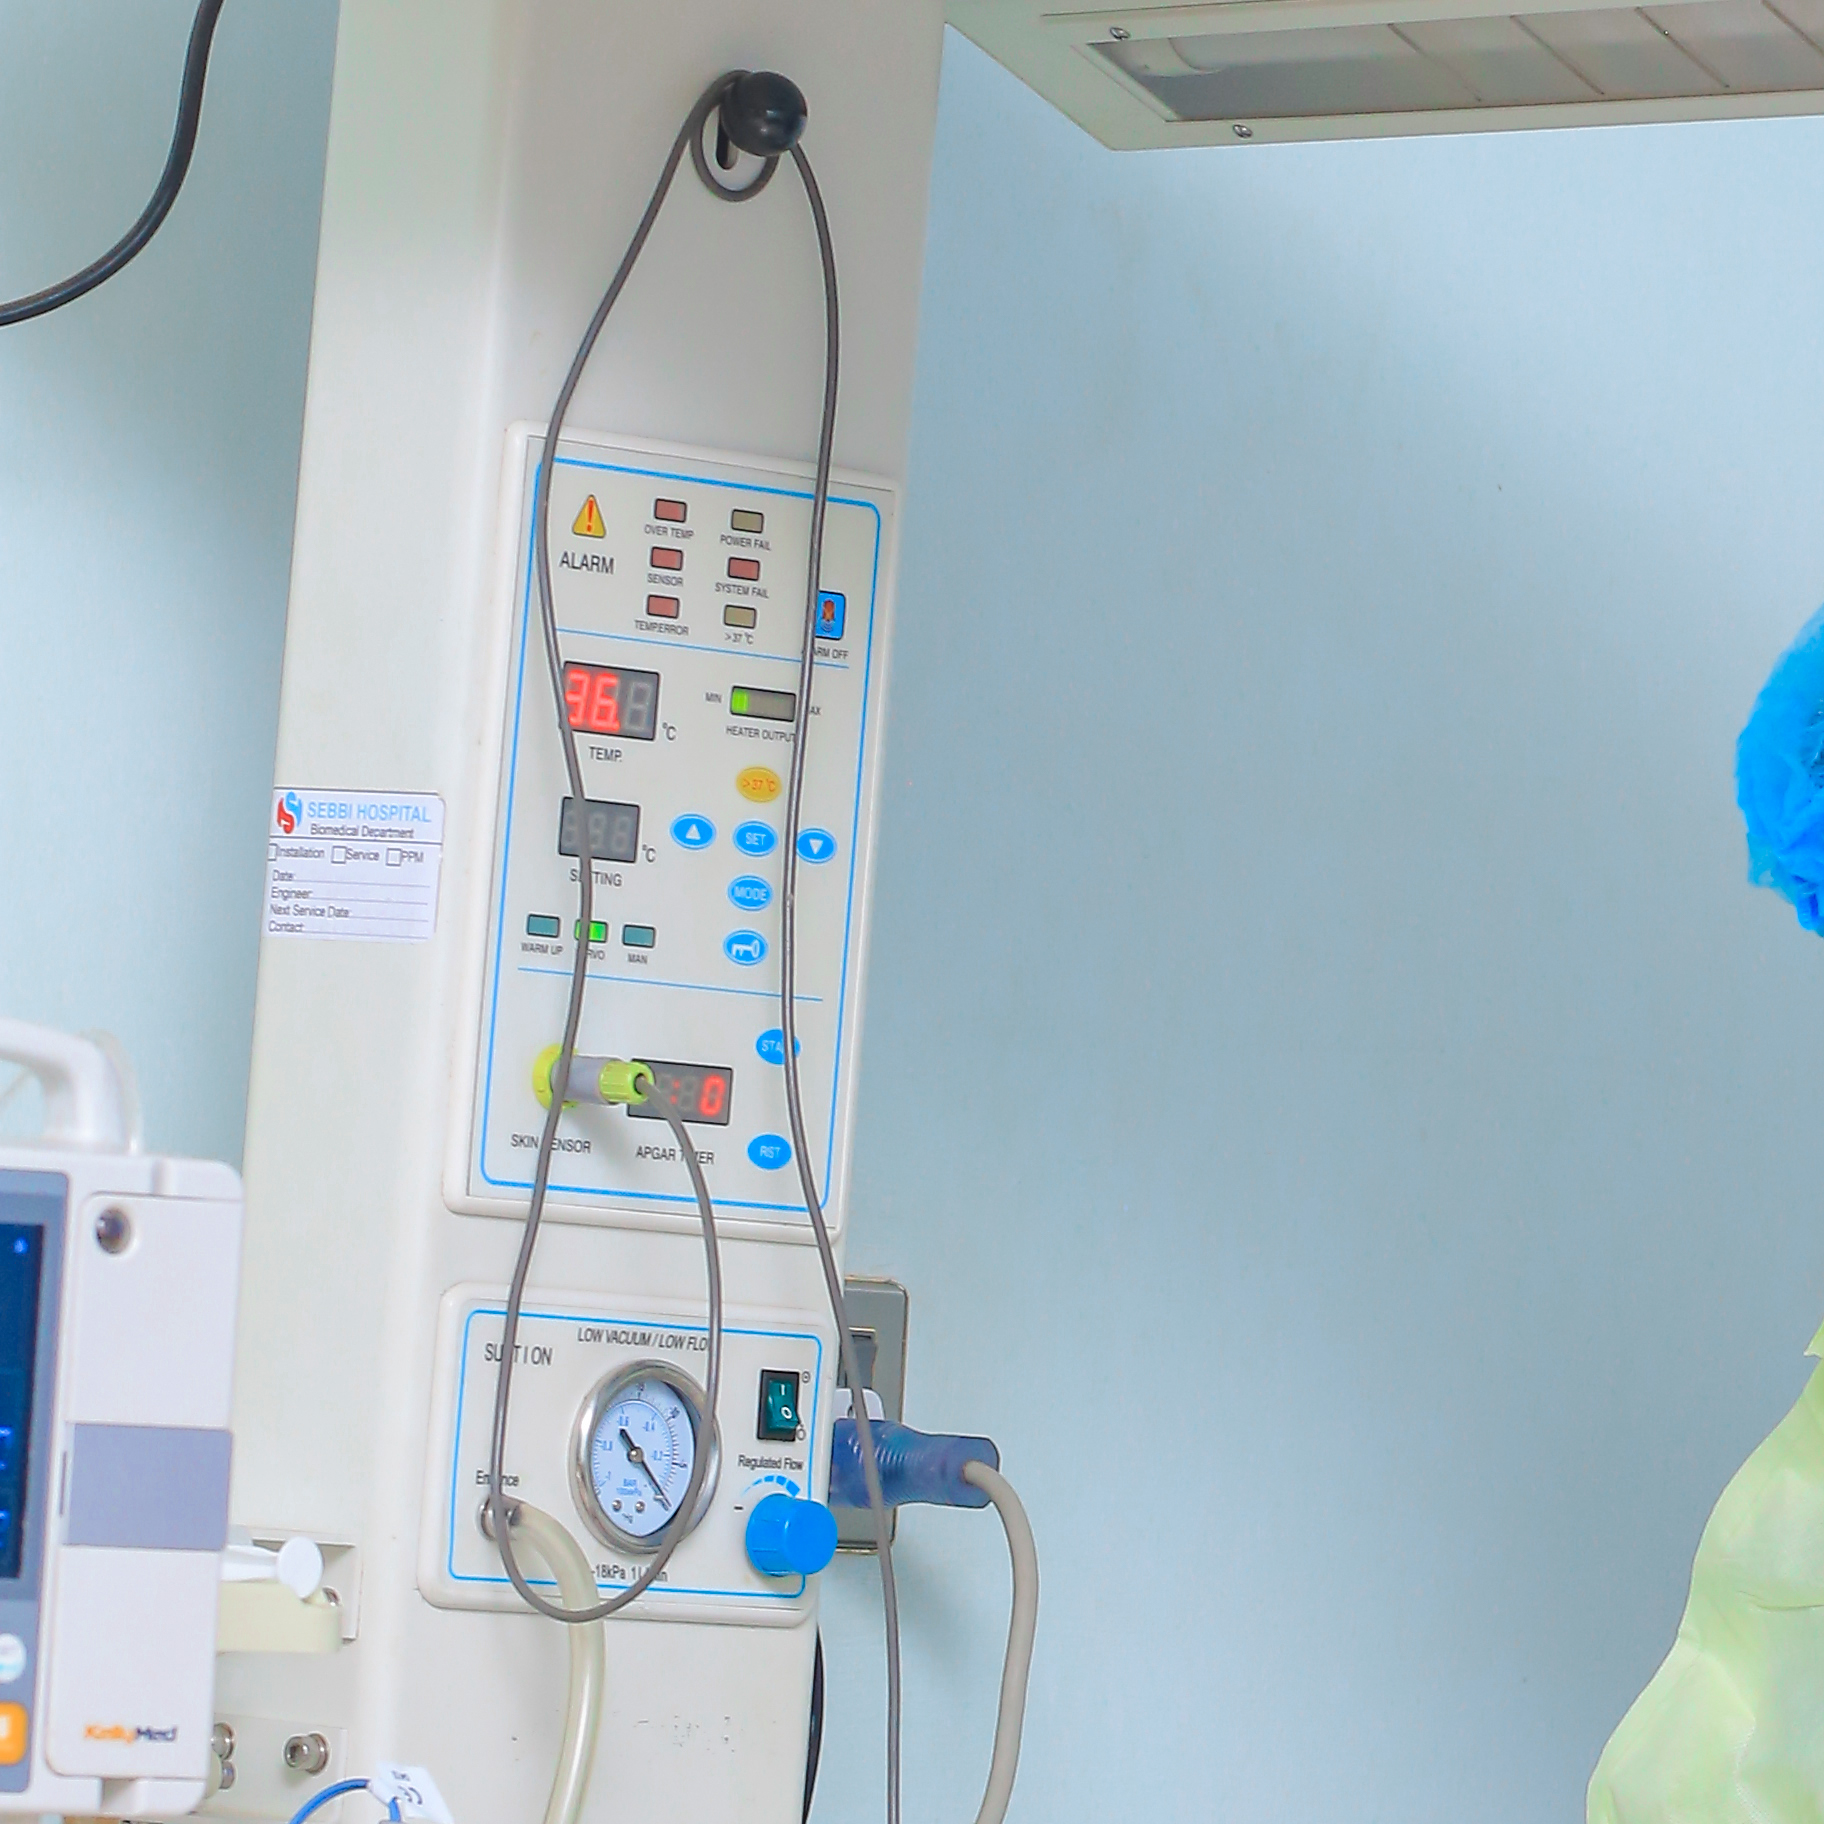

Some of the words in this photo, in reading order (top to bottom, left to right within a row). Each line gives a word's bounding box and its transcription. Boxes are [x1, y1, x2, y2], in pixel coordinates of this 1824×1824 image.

[644, 524, 668, 536] OVER
[670, 527, 694, 539] TEMP
[720, 534, 752, 547] POWER
[754, 539, 771, 551] FAIL
[559, 550, 615, 575] ALARM
[647, 573, 684, 587] SENSOR
[715, 582, 750, 596] SYSTEM
[751, 587, 770, 599] FAIL
[832, 648, 849, 660] OFF
[705, 692, 722, 703] MIN
[809, 706, 821, 716] AX
[726, 725, 760, 738] HEATER
[589, 745, 622, 762] TEMP.
[307, 801, 351, 819] SEBBI
[357, 803, 432, 823] HOSPITAL
[311, 823, 359, 837] Biomedical
[361, 825, 415, 839] Department
[745, 832, 766, 845] SET
[277, 846, 325, 859] Installation
[346, 848, 380, 862] Service
[401, 850, 424, 863] PPM
[734, 886, 768, 901] MODE
[270, 903, 290, 915] Next
[292, 904, 326, 917] Service
[521, 942, 549, 953] WARM
[551, 944, 564, 956] UP
[627, 953, 648, 965] MAN
[510, 1133, 540, 1150] SKIN
[550, 1137, 592, 1154] ENSOR
[636, 1145, 676, 1162] APGAR
[577, 1327, 603, 1343] LOW
[605, 1329, 650, 1346] VACUUM
[659, 1333, 685, 1350] LOW
[687, 1336, 709, 1352] FLO
[484, 1342, 553, 1367] SUTION
[738, 1454, 782, 1471] Regulated
[784, 1457, 804, 1471] Flow
